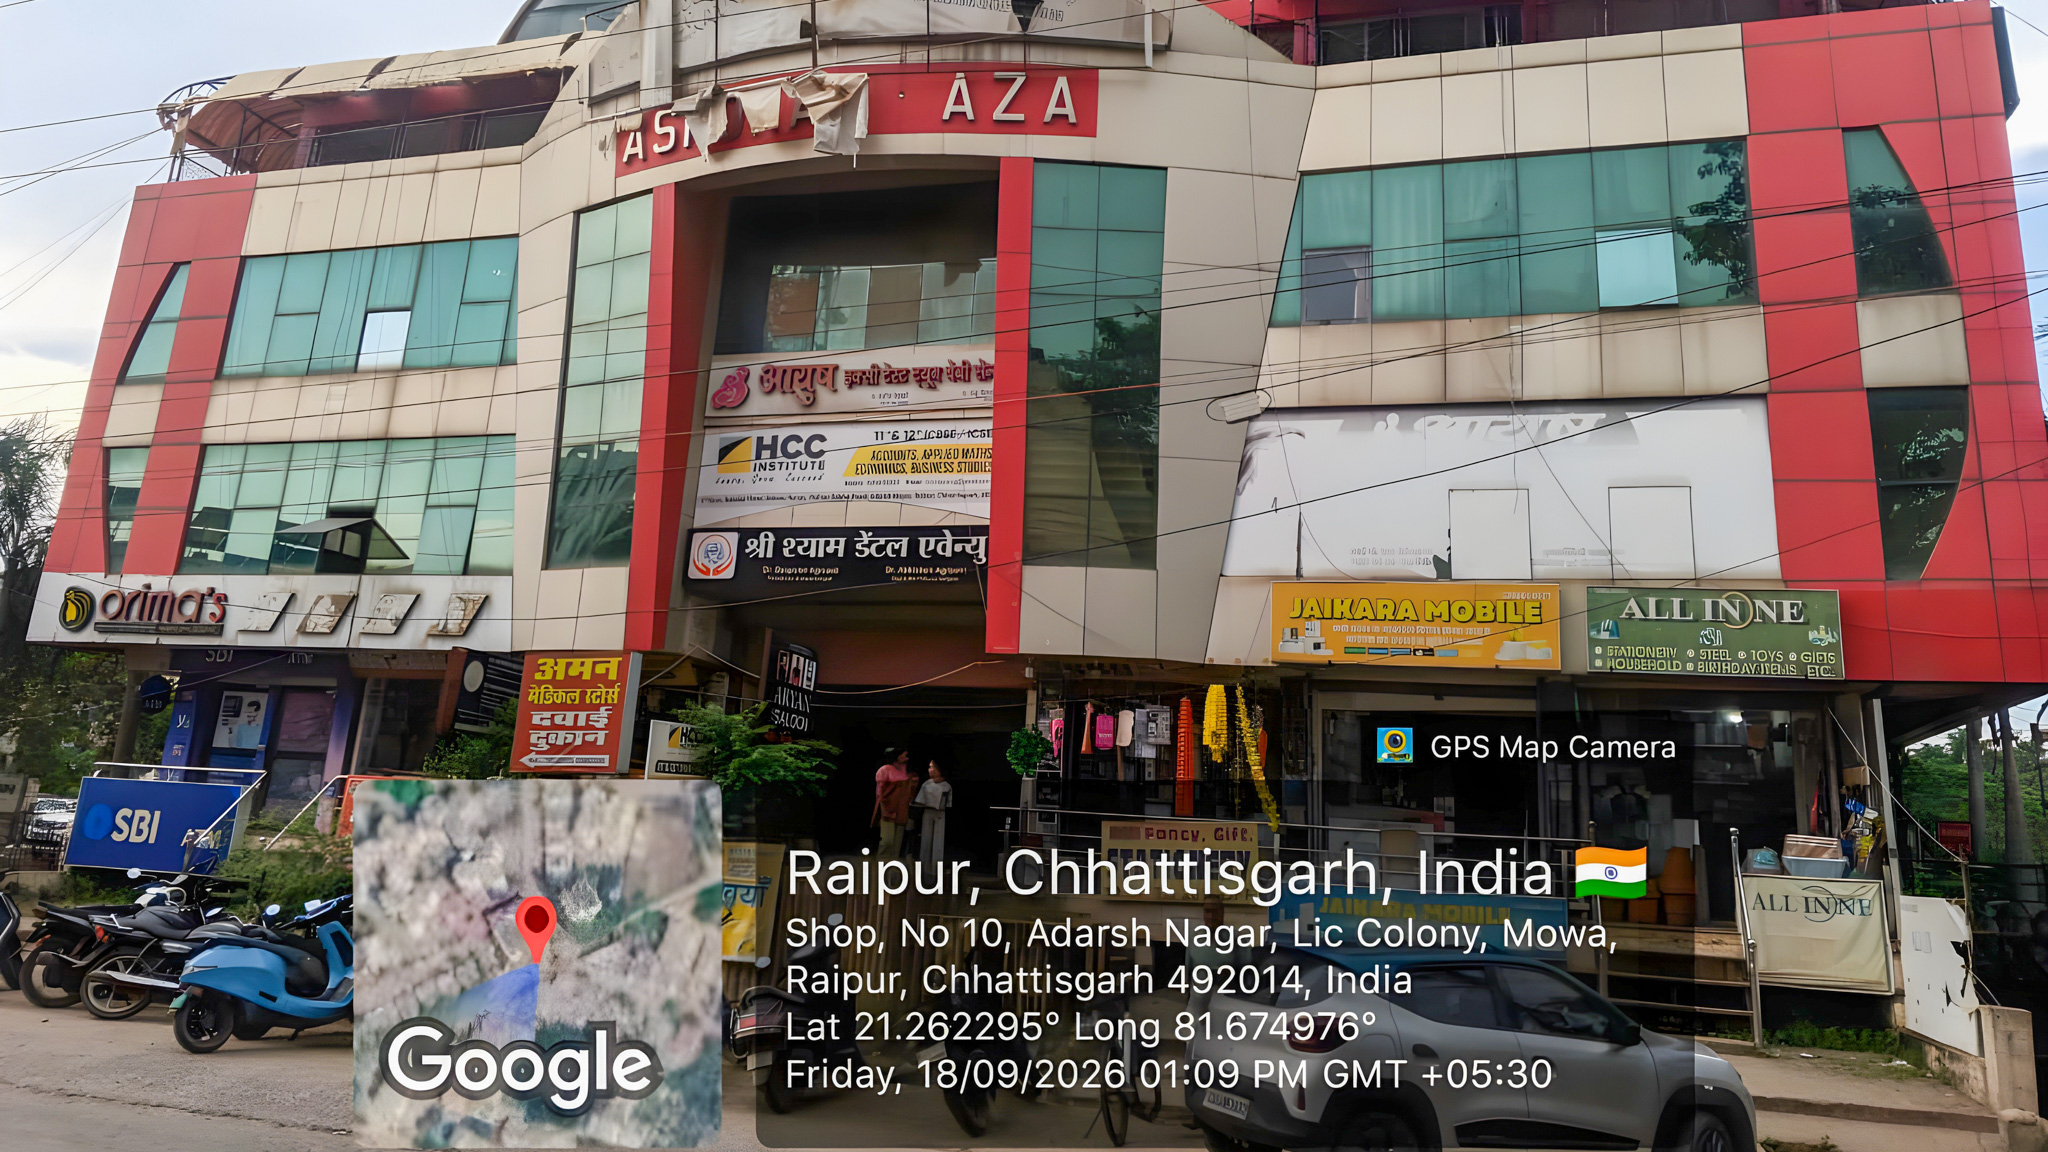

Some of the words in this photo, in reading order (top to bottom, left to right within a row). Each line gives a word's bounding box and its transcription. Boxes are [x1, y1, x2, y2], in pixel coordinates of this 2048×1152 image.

[759, 363, 839, 406] आयुष
[755, 433, 828, 460] HCC
[745, 531, 776, 559] श्री
[782, 535, 848, 559] श्याम
[853, 530, 910, 559] डेंटल
[1289, 597, 1419, 622] JAIKARA
[1424, 599, 1543, 624] MOBILE
[1619, 597, 1695, 620] ALL
[1699, 649, 1732, 661] STEEL
[1750, 650, 1784, 662] TOYS
[534, 657, 623, 681] अमन
[528, 684, 582, 705] मेडिकल
[530, 706, 613, 728] दवाई
[529, 730, 610, 751] दुकान
[111, 808, 162, 844] SBI
[1752, 892, 1798, 913] ALL
